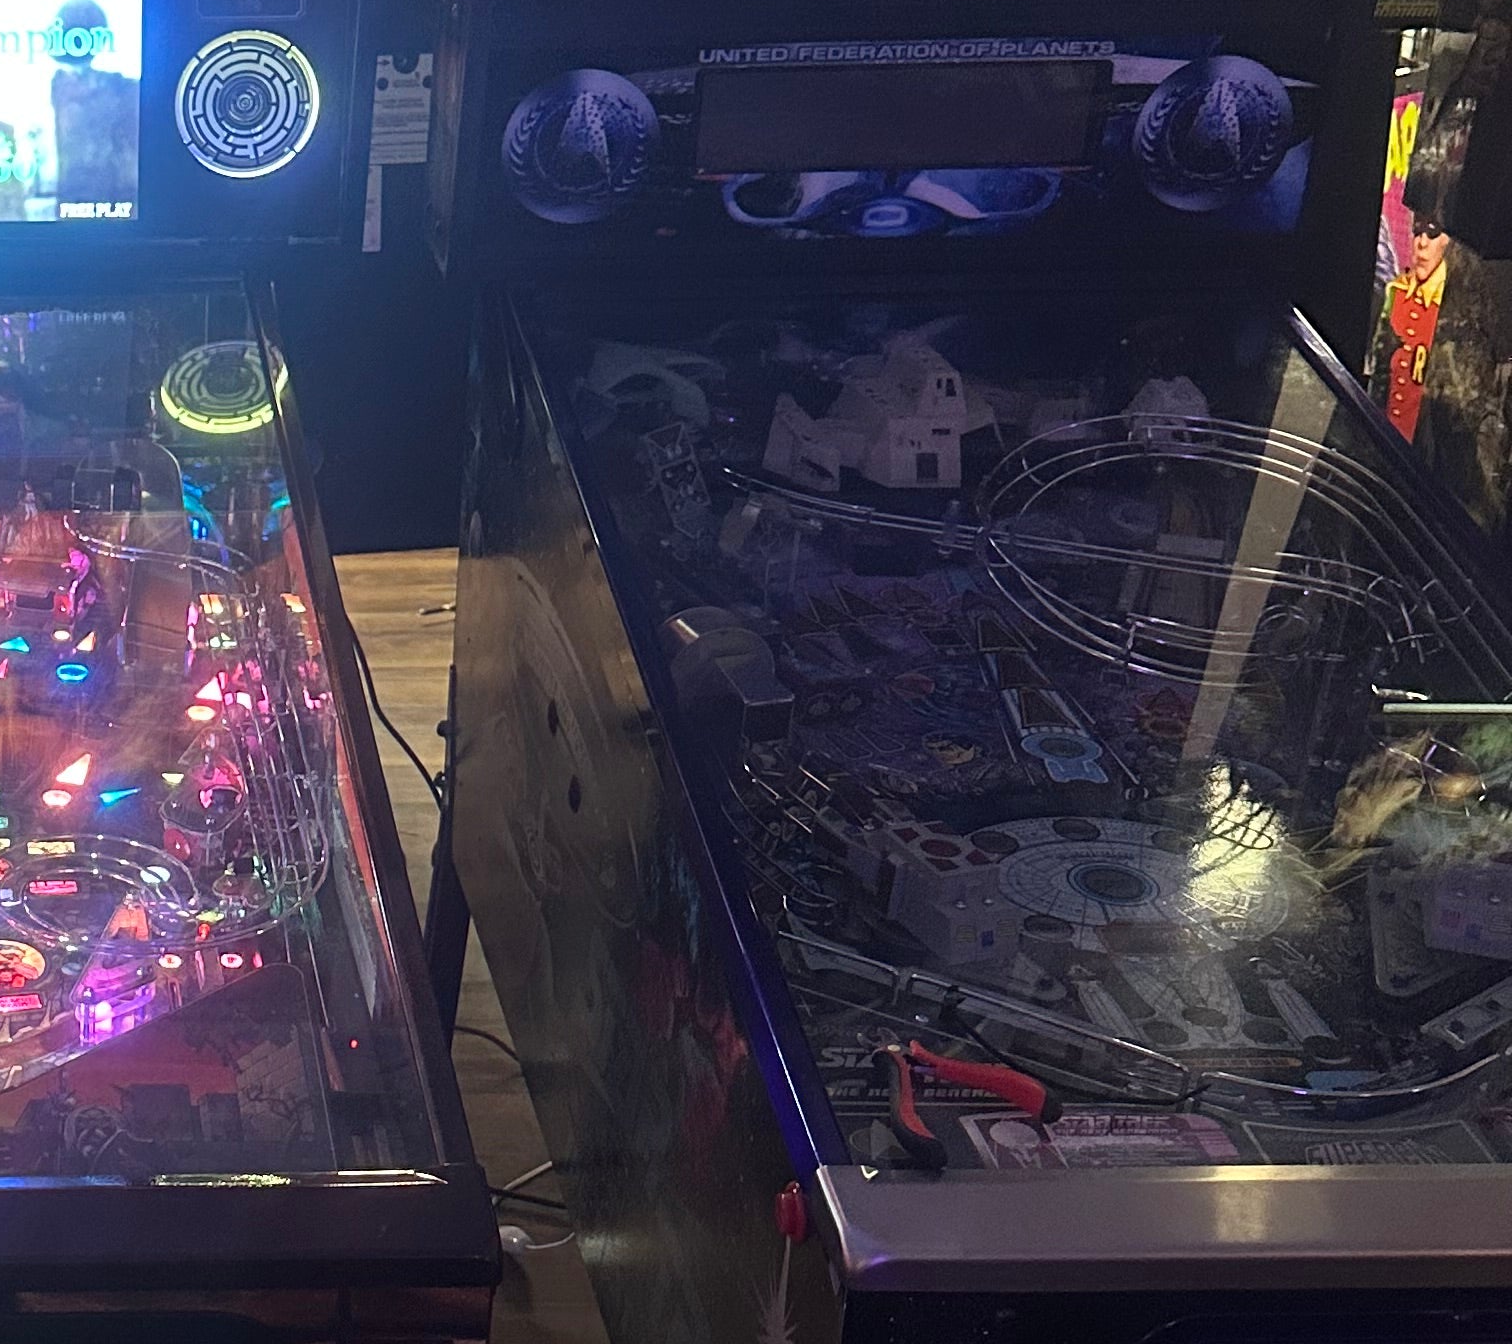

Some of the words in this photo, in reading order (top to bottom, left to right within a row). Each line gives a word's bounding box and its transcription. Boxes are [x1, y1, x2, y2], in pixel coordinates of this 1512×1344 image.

[698, 47, 788, 64] UNITED
[797, 44, 949, 63] FEDERATION
[958, 43, 991, 58] OF
[1001, 40, 1117, 58] PLANETS
[95, 203, 133, 218] PLAY
